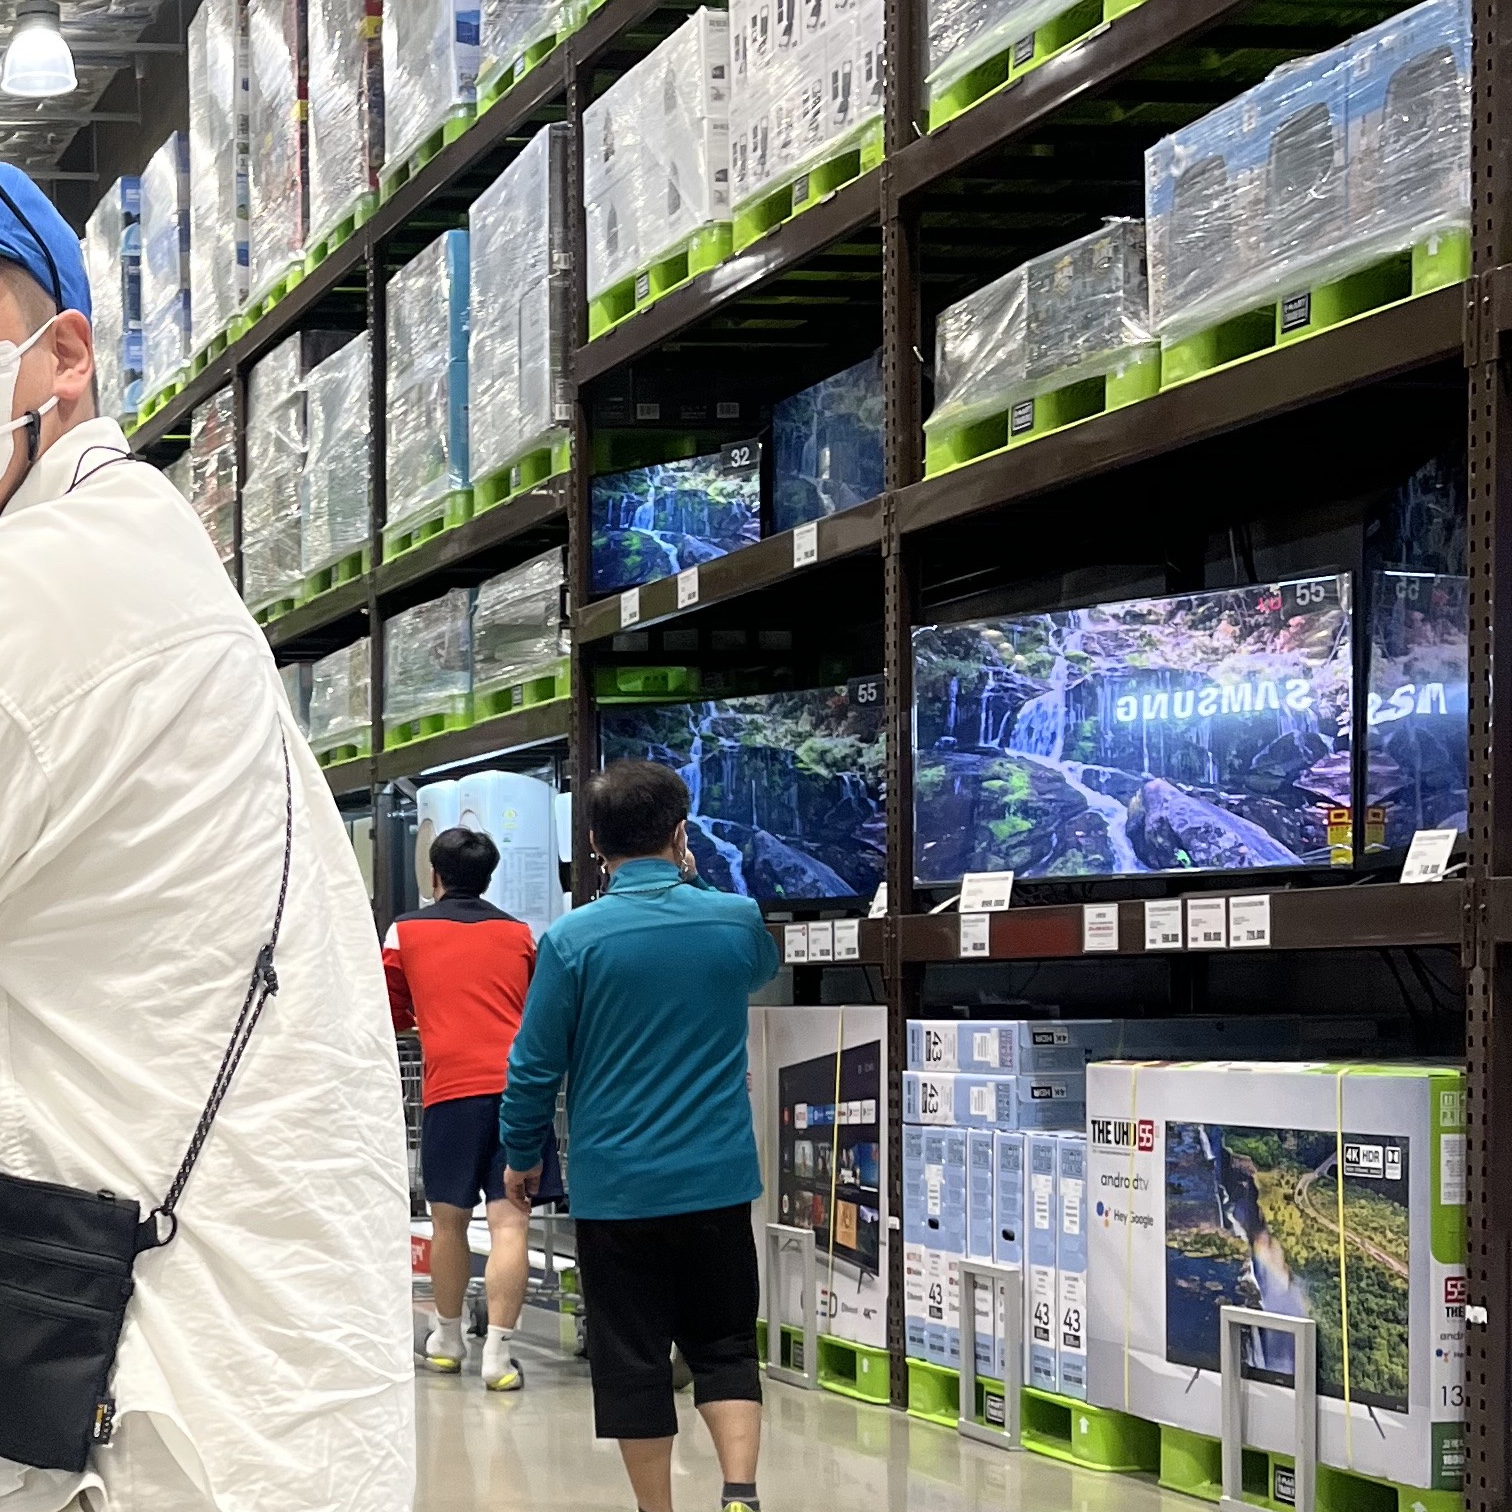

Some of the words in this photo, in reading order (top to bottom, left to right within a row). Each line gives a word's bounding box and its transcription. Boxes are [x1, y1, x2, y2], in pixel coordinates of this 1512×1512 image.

[731, 447, 750, 468] 32
[1296, 582, 1325, 606] 55
[857, 683, 877, 703] 55
[931, 1031, 943, 1062] 43
[927, 1083, 939, 1114] 43
[1090, 1119, 1112, 1145] THE
[1113, 1120, 1137, 1147] UHD
[1346, 1146, 1360, 1164] 4K
[1362, 1149, 1380, 1164] HDR
[928, 1282, 943, 1306] 43
[1034, 1301, 1050, 1326] 43
[1063, 1307, 1081, 1333] 43
